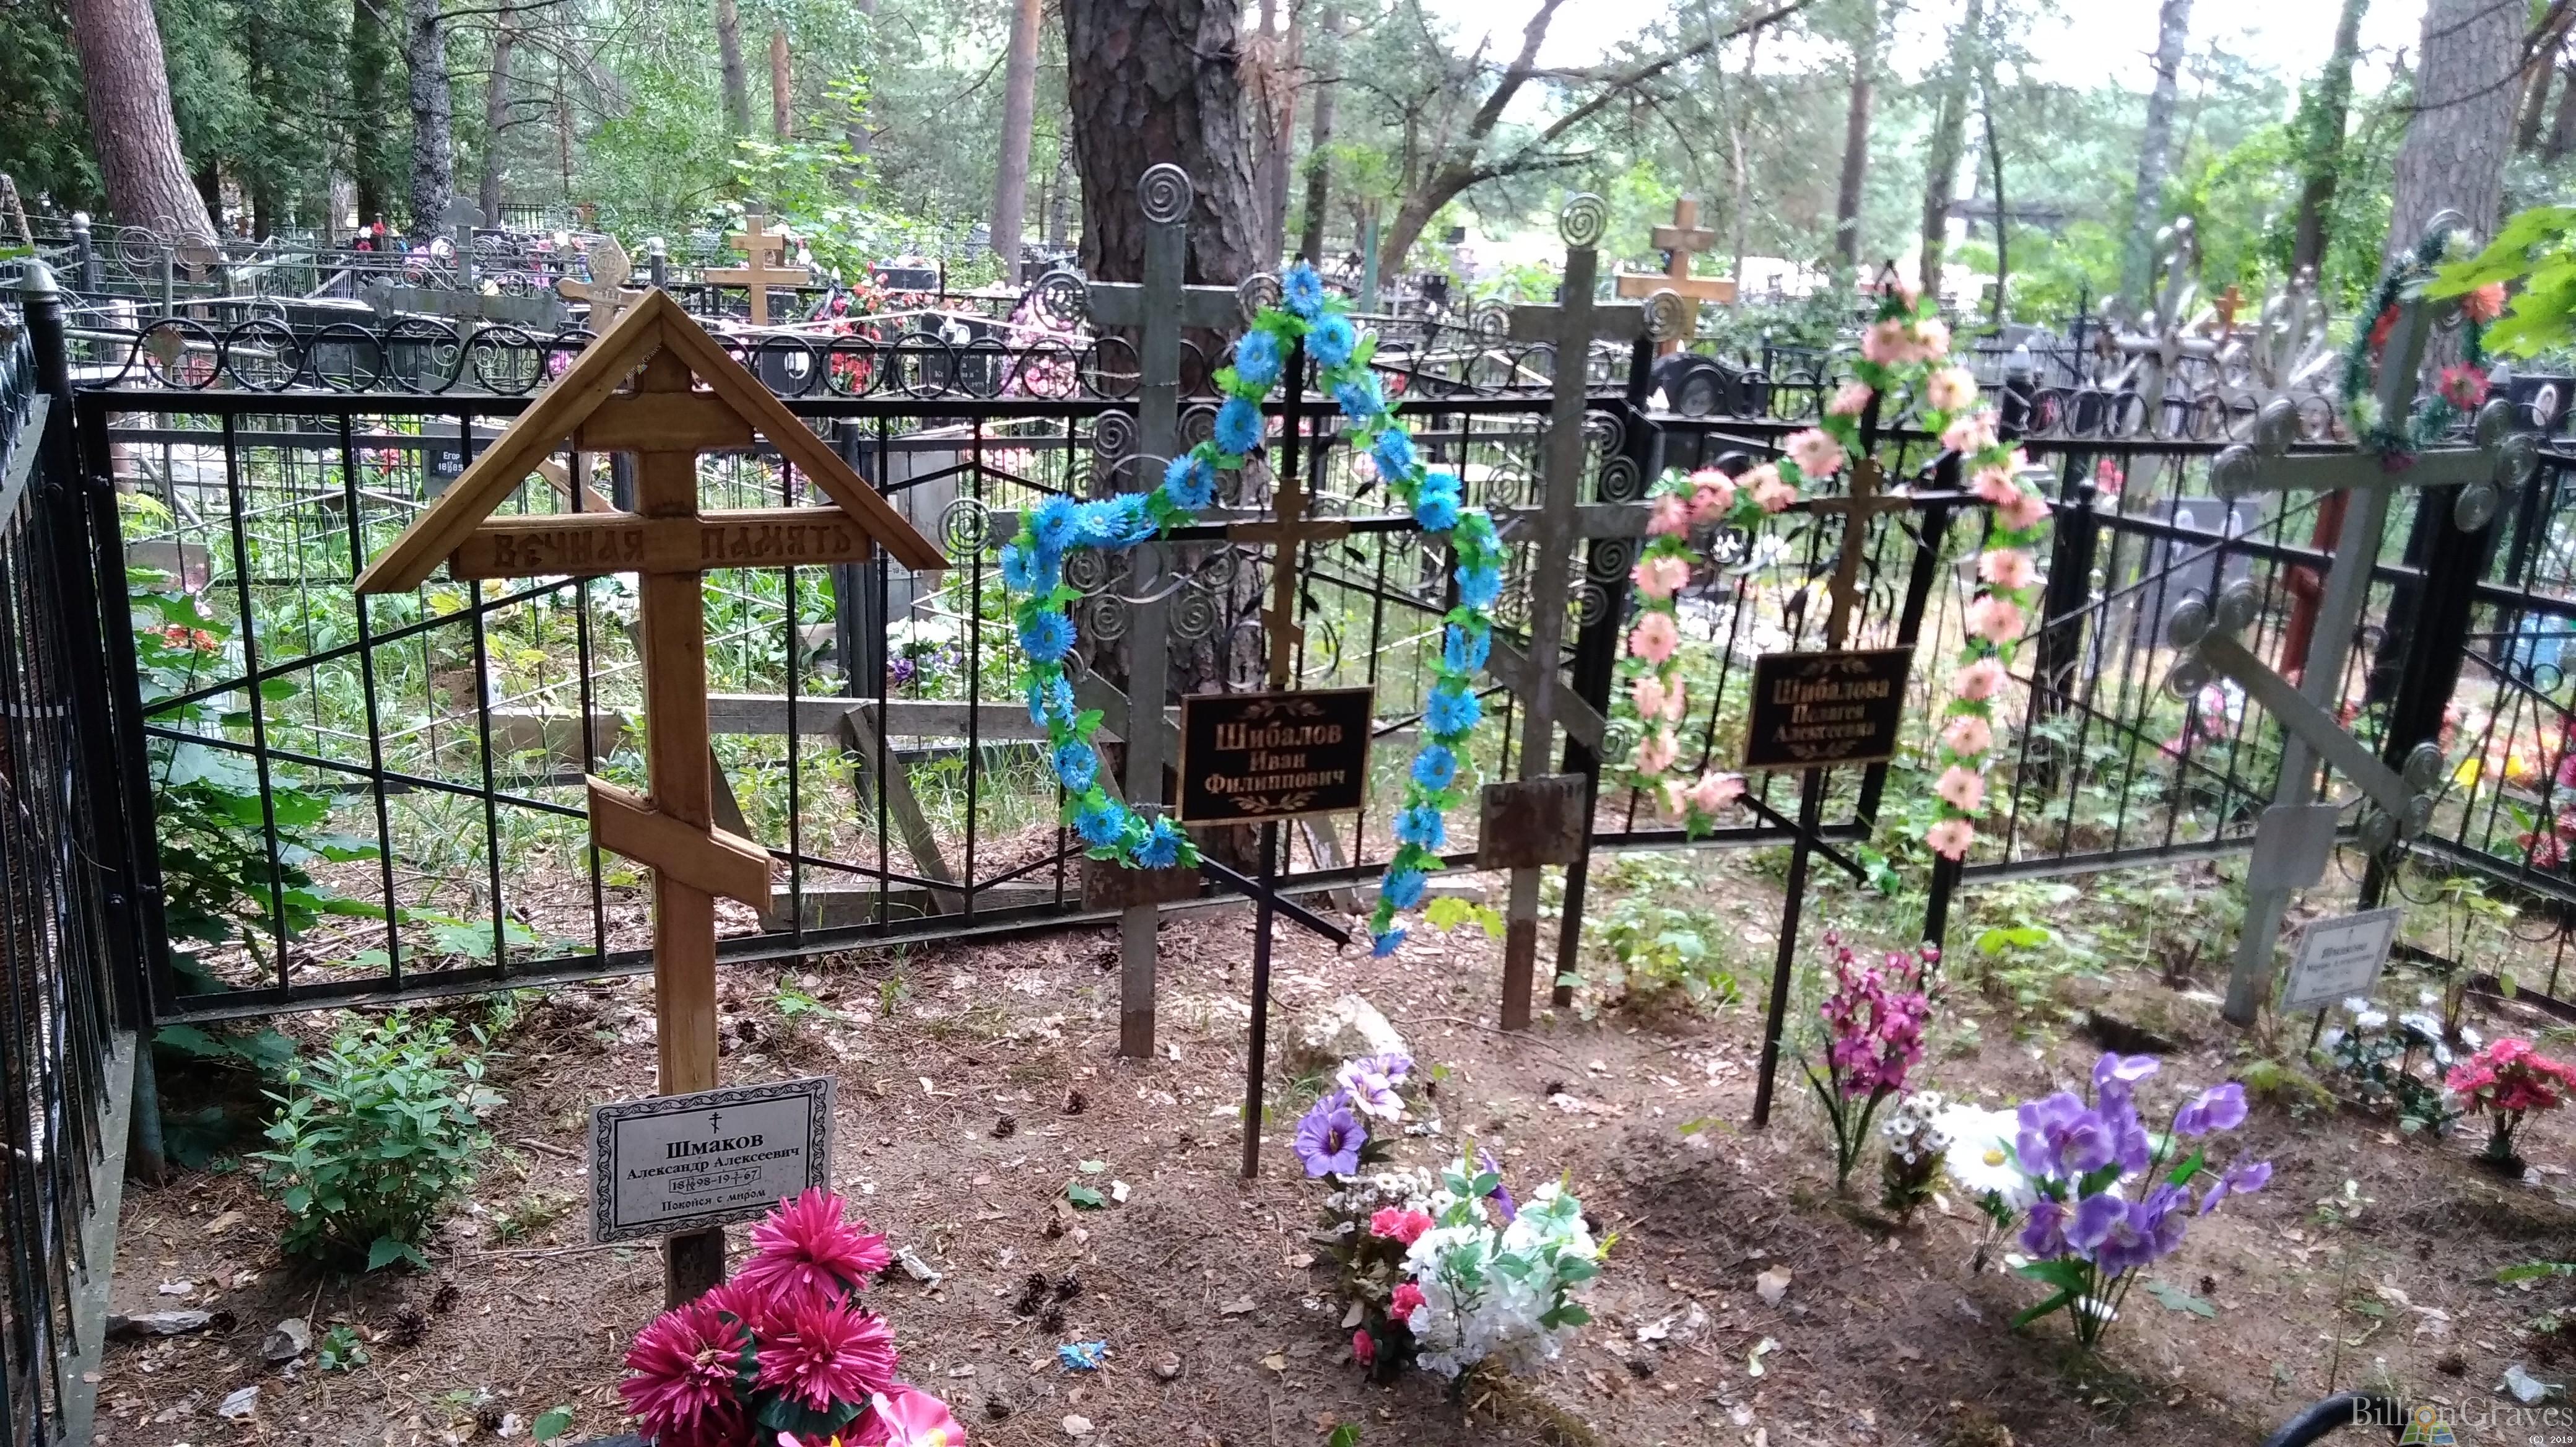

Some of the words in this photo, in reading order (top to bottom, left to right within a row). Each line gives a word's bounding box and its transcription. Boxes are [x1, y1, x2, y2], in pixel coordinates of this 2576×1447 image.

[1215, 720, 1343, 751] Шибалов
[1248, 750, 1307, 772] Иван
[1204, 769, 1346, 794] Филиппович
[666, 1134, 764, 1160] Шмаков
[627, 1160, 709, 1181] Александр
[714, 1147, 800, 1168] Алексеевич
[661, 1197, 712, 1212] Покойся
[727, 1189, 766, 1202] миром
